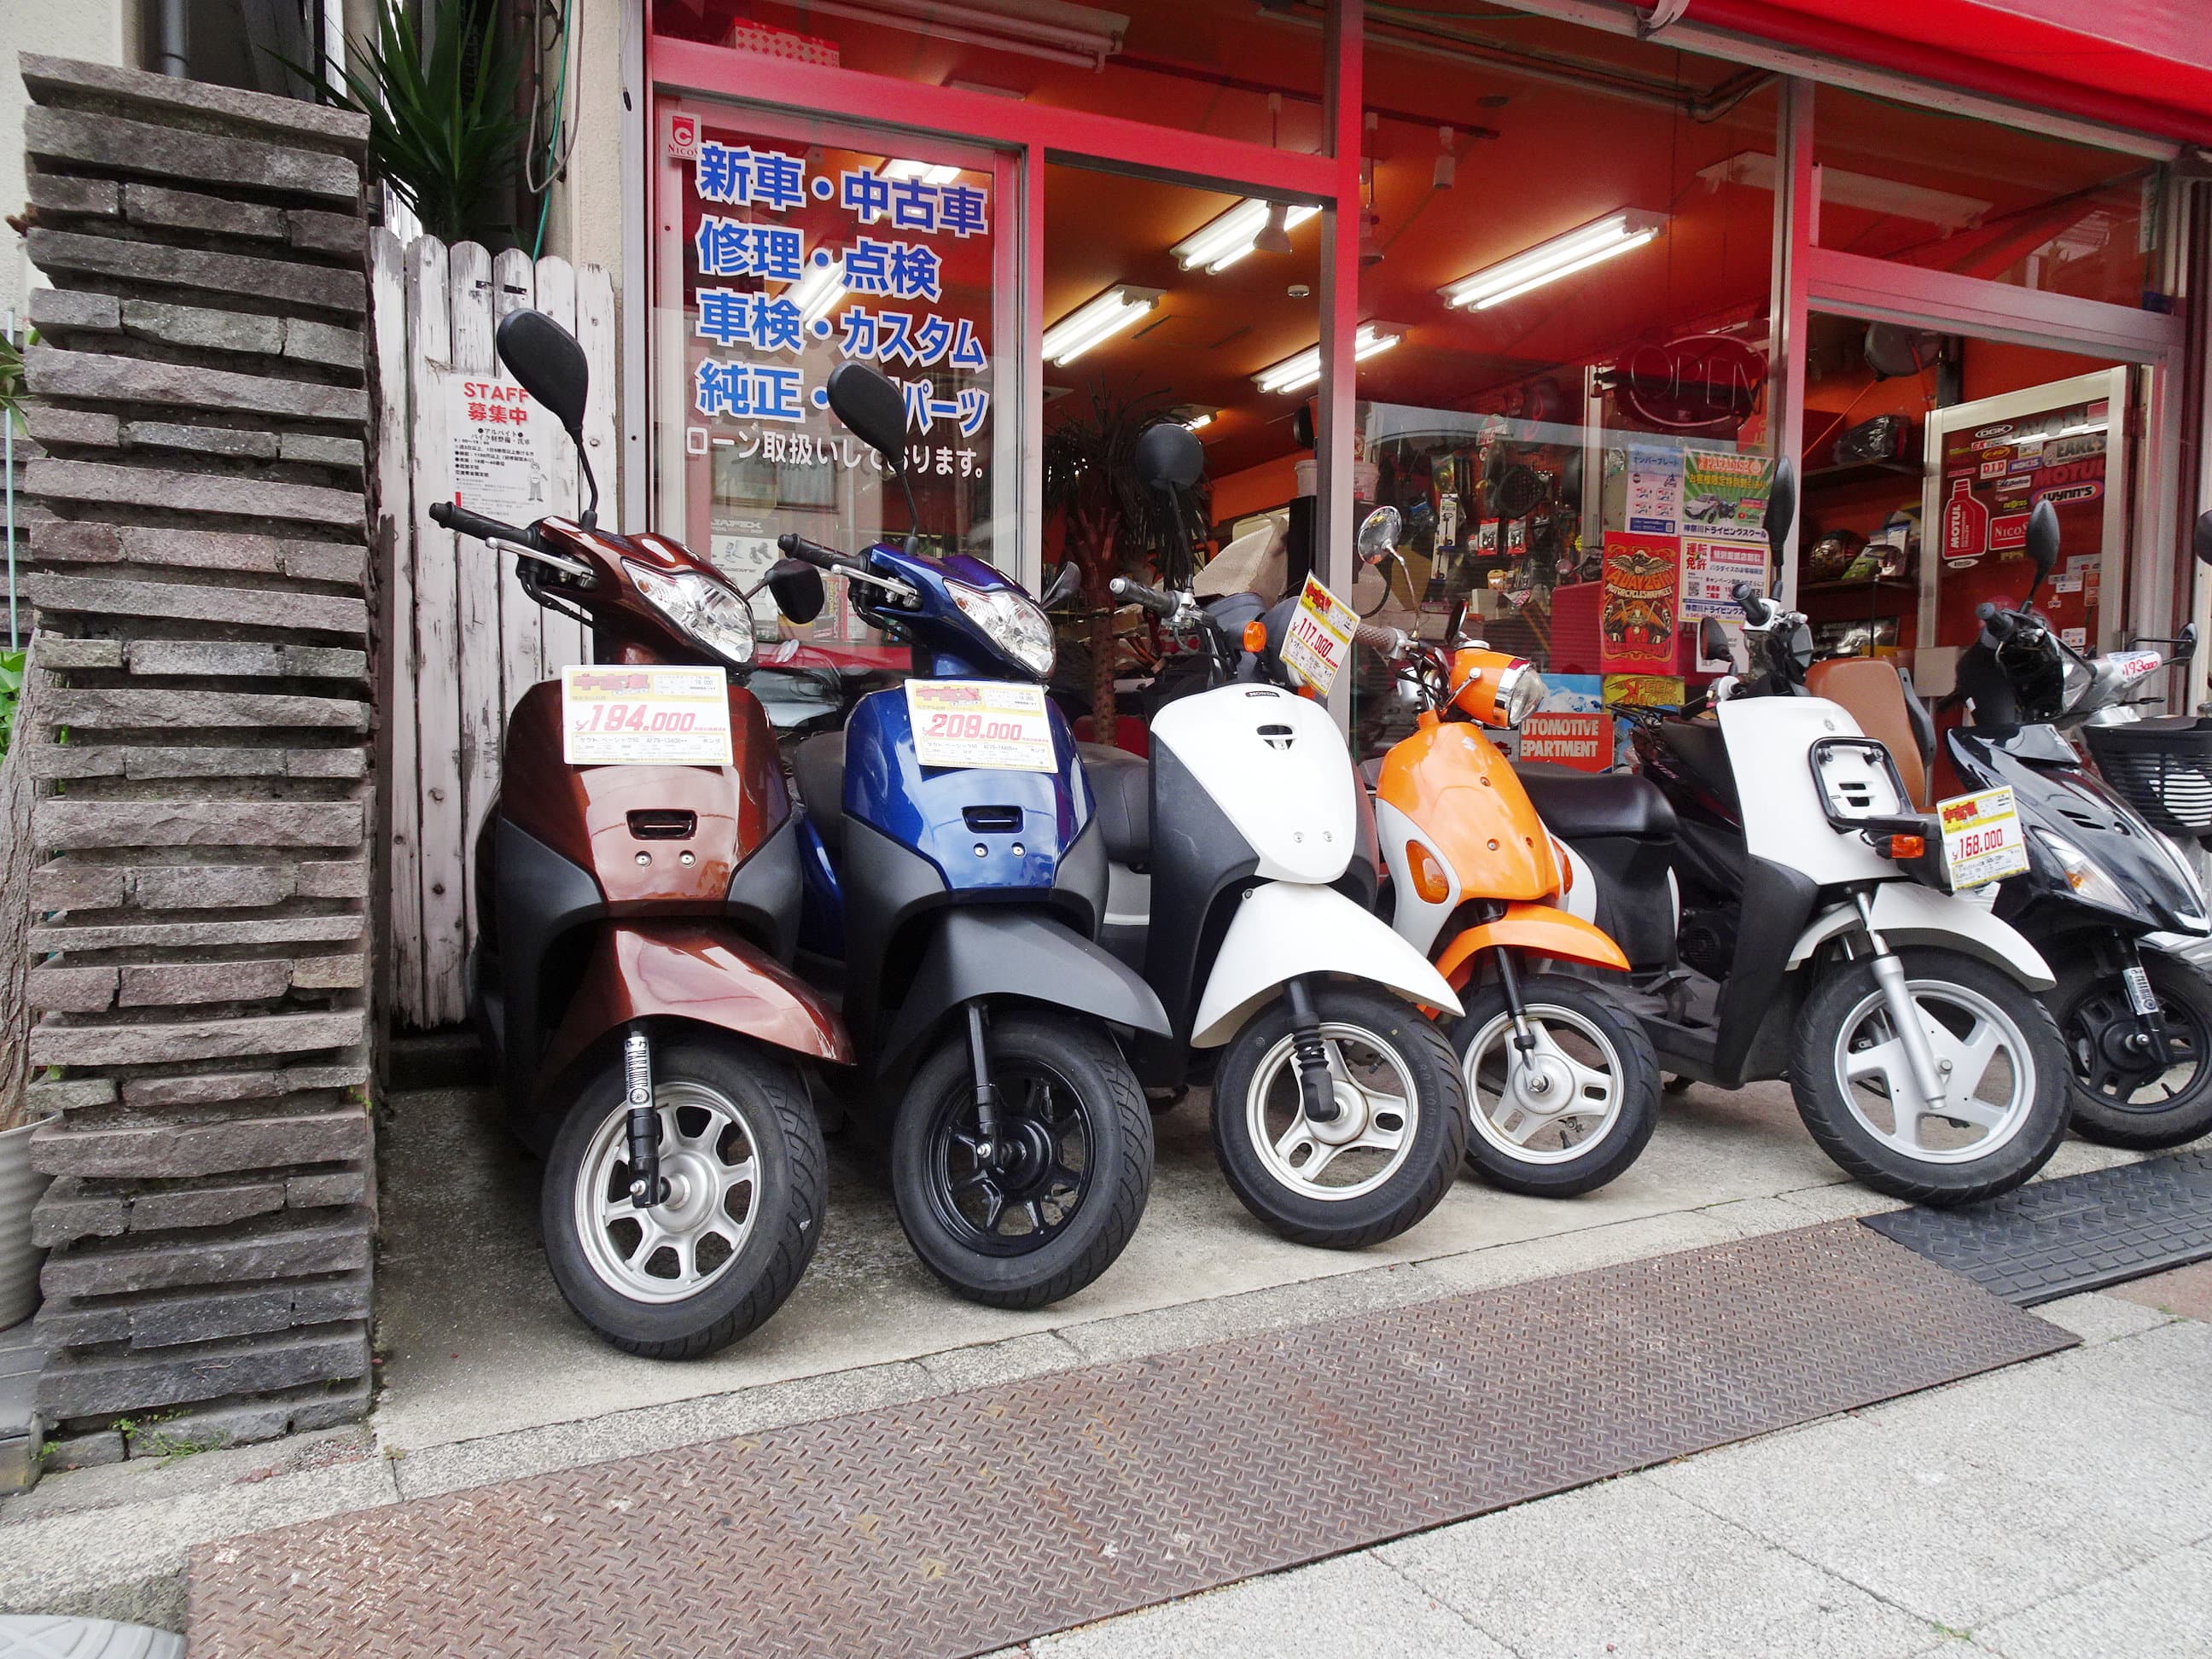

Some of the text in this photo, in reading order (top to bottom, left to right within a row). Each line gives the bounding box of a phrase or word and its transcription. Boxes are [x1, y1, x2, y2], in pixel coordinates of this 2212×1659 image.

[697, 142, 988, 237] 新車・中古車
[696, 215, 942, 302] 修理・点検
[696, 288, 988, 372] 車検・カスタム
[463, 382, 529, 404] STAFF
[468, 402, 527, 427] 募集中
[695, 360, 990, 438] 純正・パーツ
[1520, 740, 1598, 758] EPARTMENT
[1521, 719, 1599, 736] UTOMOTIVE
